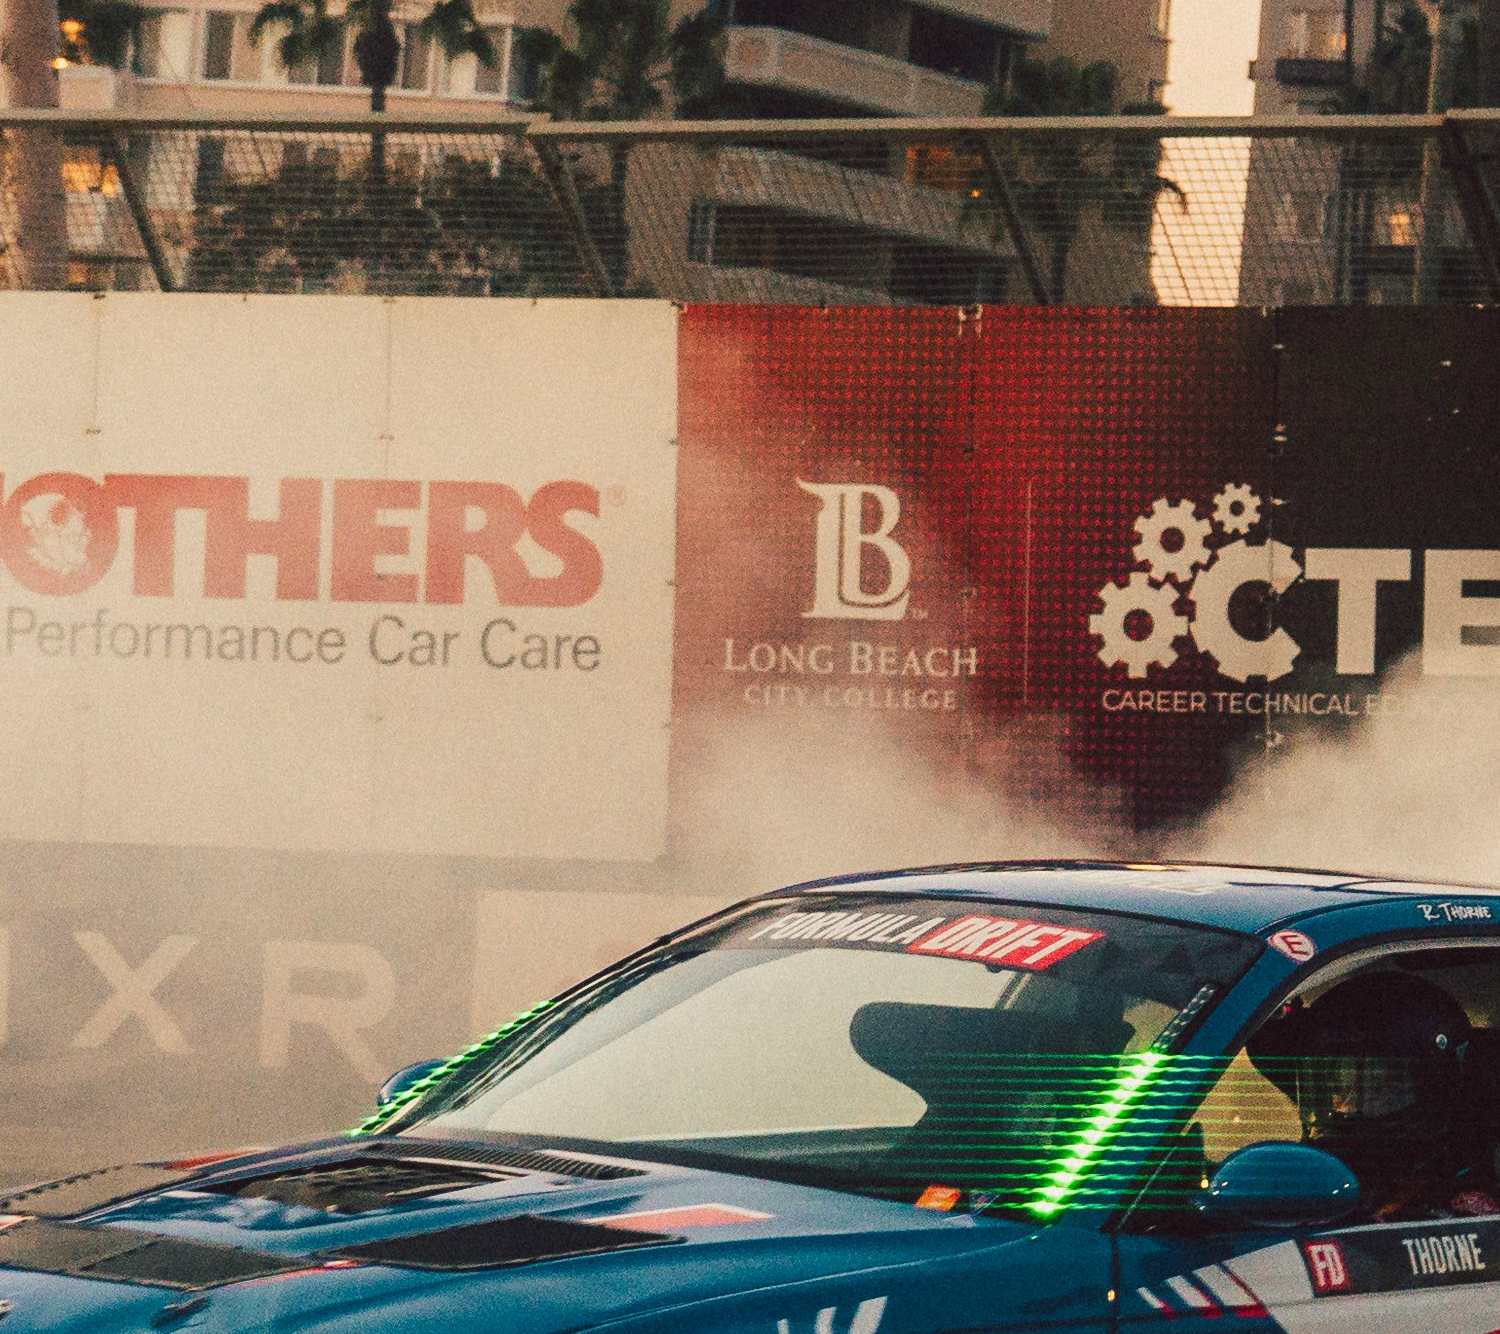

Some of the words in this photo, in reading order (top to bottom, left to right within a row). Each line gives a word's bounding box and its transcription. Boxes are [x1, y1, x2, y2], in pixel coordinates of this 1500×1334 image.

[6, 605, 346, 665] Performance
[369, 614, 459, 666] Car
[480, 617, 601, 671] Care
[724, 638, 835, 675] LONG
[850, 640, 978, 677] BEACH
[742, 685, 808, 708] CITY
[824, 686, 957, 710] COLLEGE
[1102, 689, 1206, 713] CAREER
[1215, 692, 1359, 716] TECHNICAL
[749, 911, 947, 946] FORMULA
[921, 915, 1096, 965] DRIFT
[1403, 1233, 1486, 1276] THORNE
